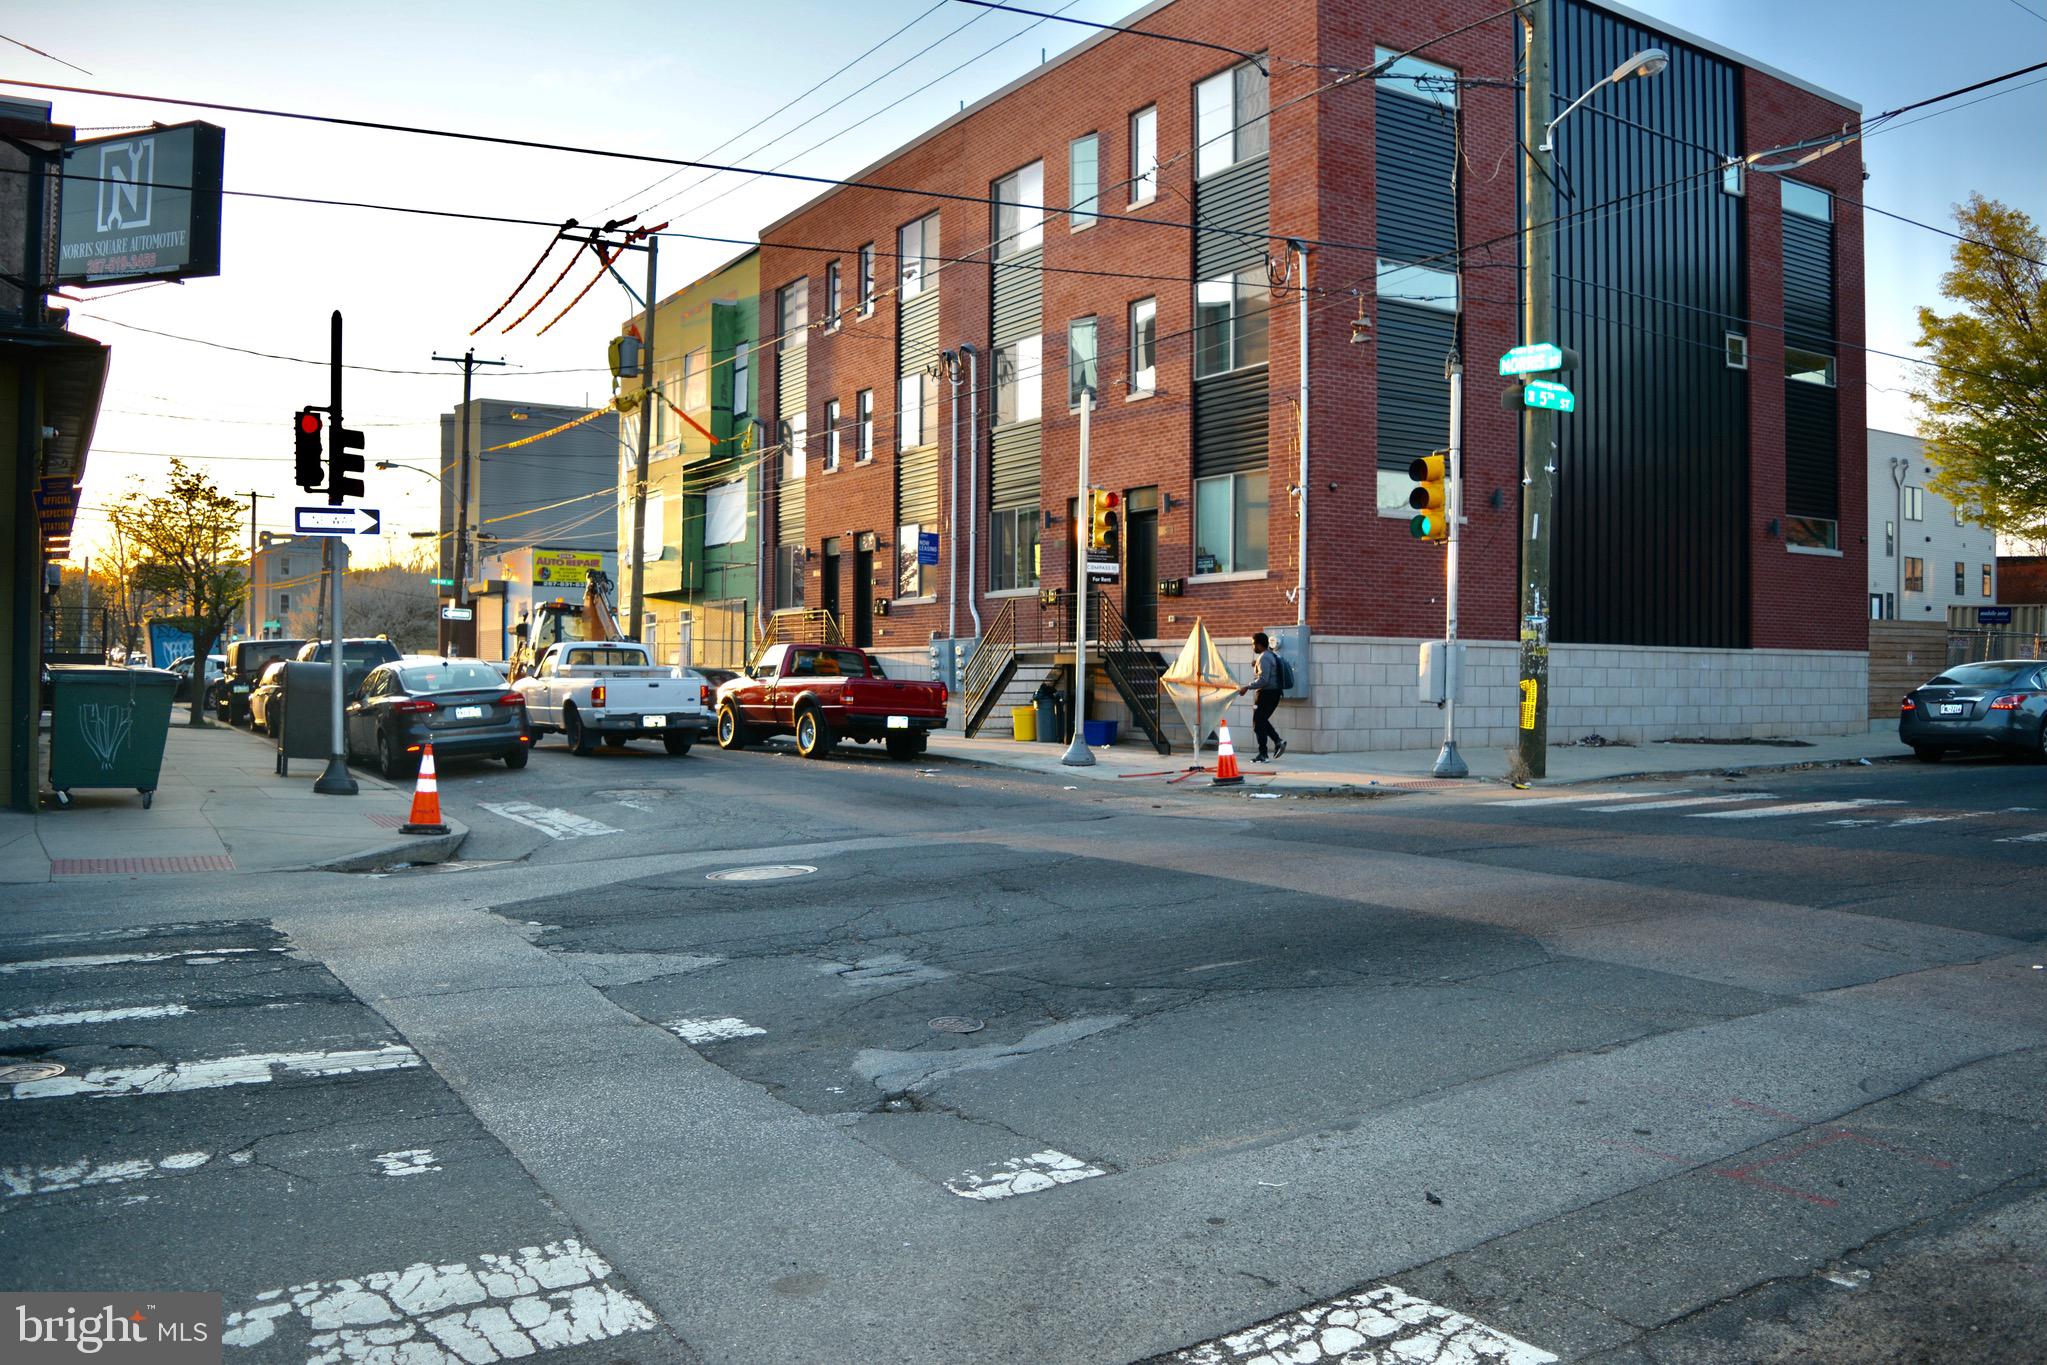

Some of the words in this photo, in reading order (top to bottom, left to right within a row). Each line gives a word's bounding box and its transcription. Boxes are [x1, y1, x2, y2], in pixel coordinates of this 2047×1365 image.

[61, 242, 94, 260] NORRIS
[95, 238, 128, 256] SQUARE
[131, 230, 186, 251] AUTOMOTIVE
[1560, 399, 1571, 409] ST
[43, 496, 71, 505] OFFICIAL
[43, 522, 70, 532] STATION
[536, 556, 564, 566] AUTO
[566, 559, 600, 568] REPAIR
